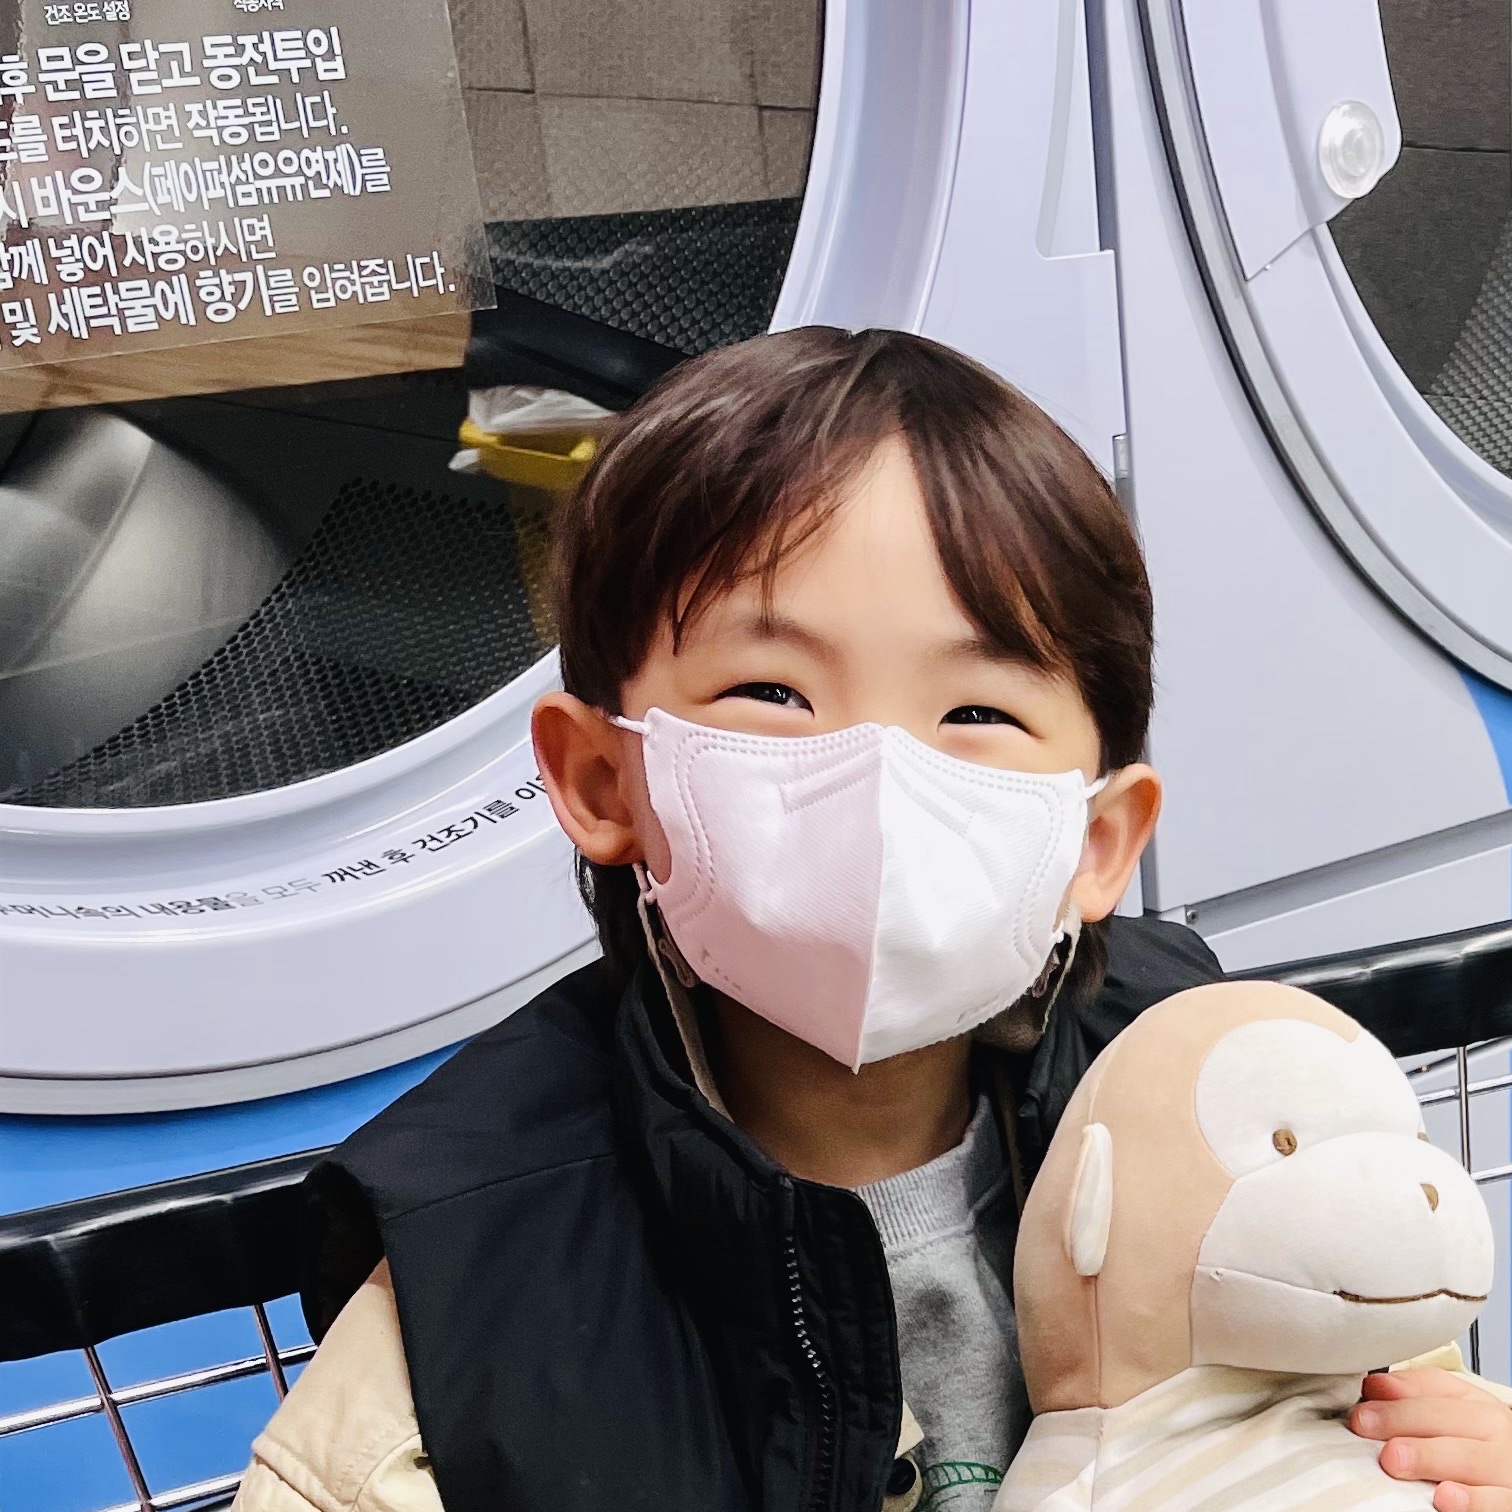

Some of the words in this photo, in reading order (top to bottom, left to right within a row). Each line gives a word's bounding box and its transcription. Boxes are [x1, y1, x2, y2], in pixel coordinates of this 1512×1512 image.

[44, 3, 73, 25] 건조
[73, 3, 103, 23] 온도
[102, 0, 131, 21] 설정
[37, 42, 118, 102] 문을
[118, 38, 201, 95] 닫고
[202, 27, 346, 90] 동전투입
[51, 102, 183, 158] 터치하면
[185, 90, 349, 146] 작동됩니다.
[0, 181, 28, 228] 시
[30, 147, 391, 225] 바운스(페이퍼섬유유연제)를
[48, 230, 118, 283] 넣어
[122, 214, 275, 273] 사용하시면
[1, 298, 42, 348] 및
[47, 273, 197, 340] 세탁물에
[196, 264, 300, 322] 향기를
[302, 250, 456, 309] 입혀줍니다.
[261, 878, 322, 901] 모두
[321, 859, 387, 883] 꺼낸
[380, 848, 416, 865] 후
[411, 799, 520, 852] 건조기를
[514, 773, 547, 800] 이
